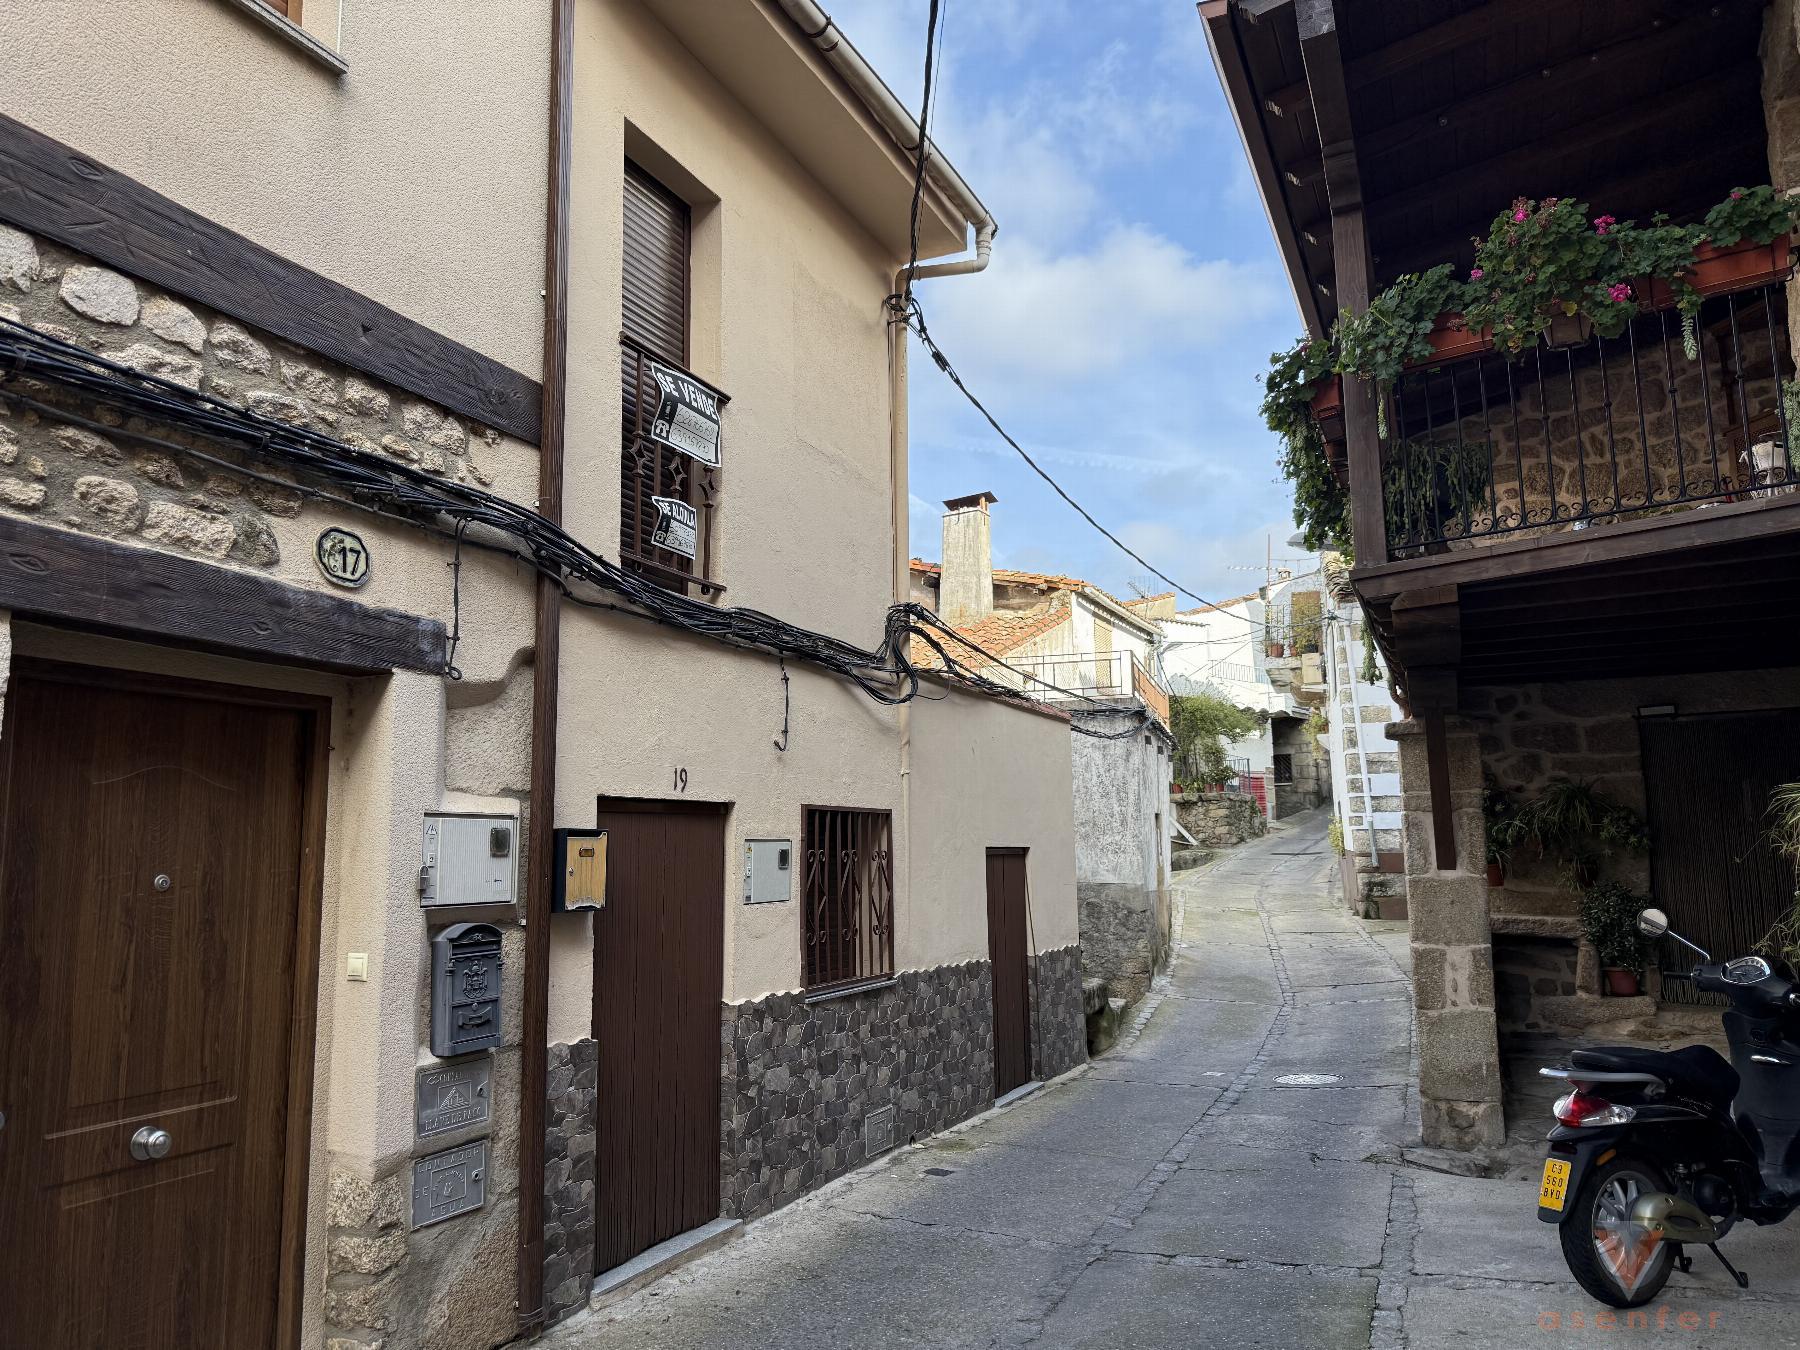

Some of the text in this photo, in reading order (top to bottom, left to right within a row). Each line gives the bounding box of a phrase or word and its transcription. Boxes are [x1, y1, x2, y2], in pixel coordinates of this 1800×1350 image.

[656, 371, 680, 398] SE
[678, 380, 718, 421] VENDE
[658, 501, 671, 516] SE
[338, 545, 362, 577] 17
[673, 767, 688, 793] 19
[418, 1147, 480, 1174] CONTADOR
